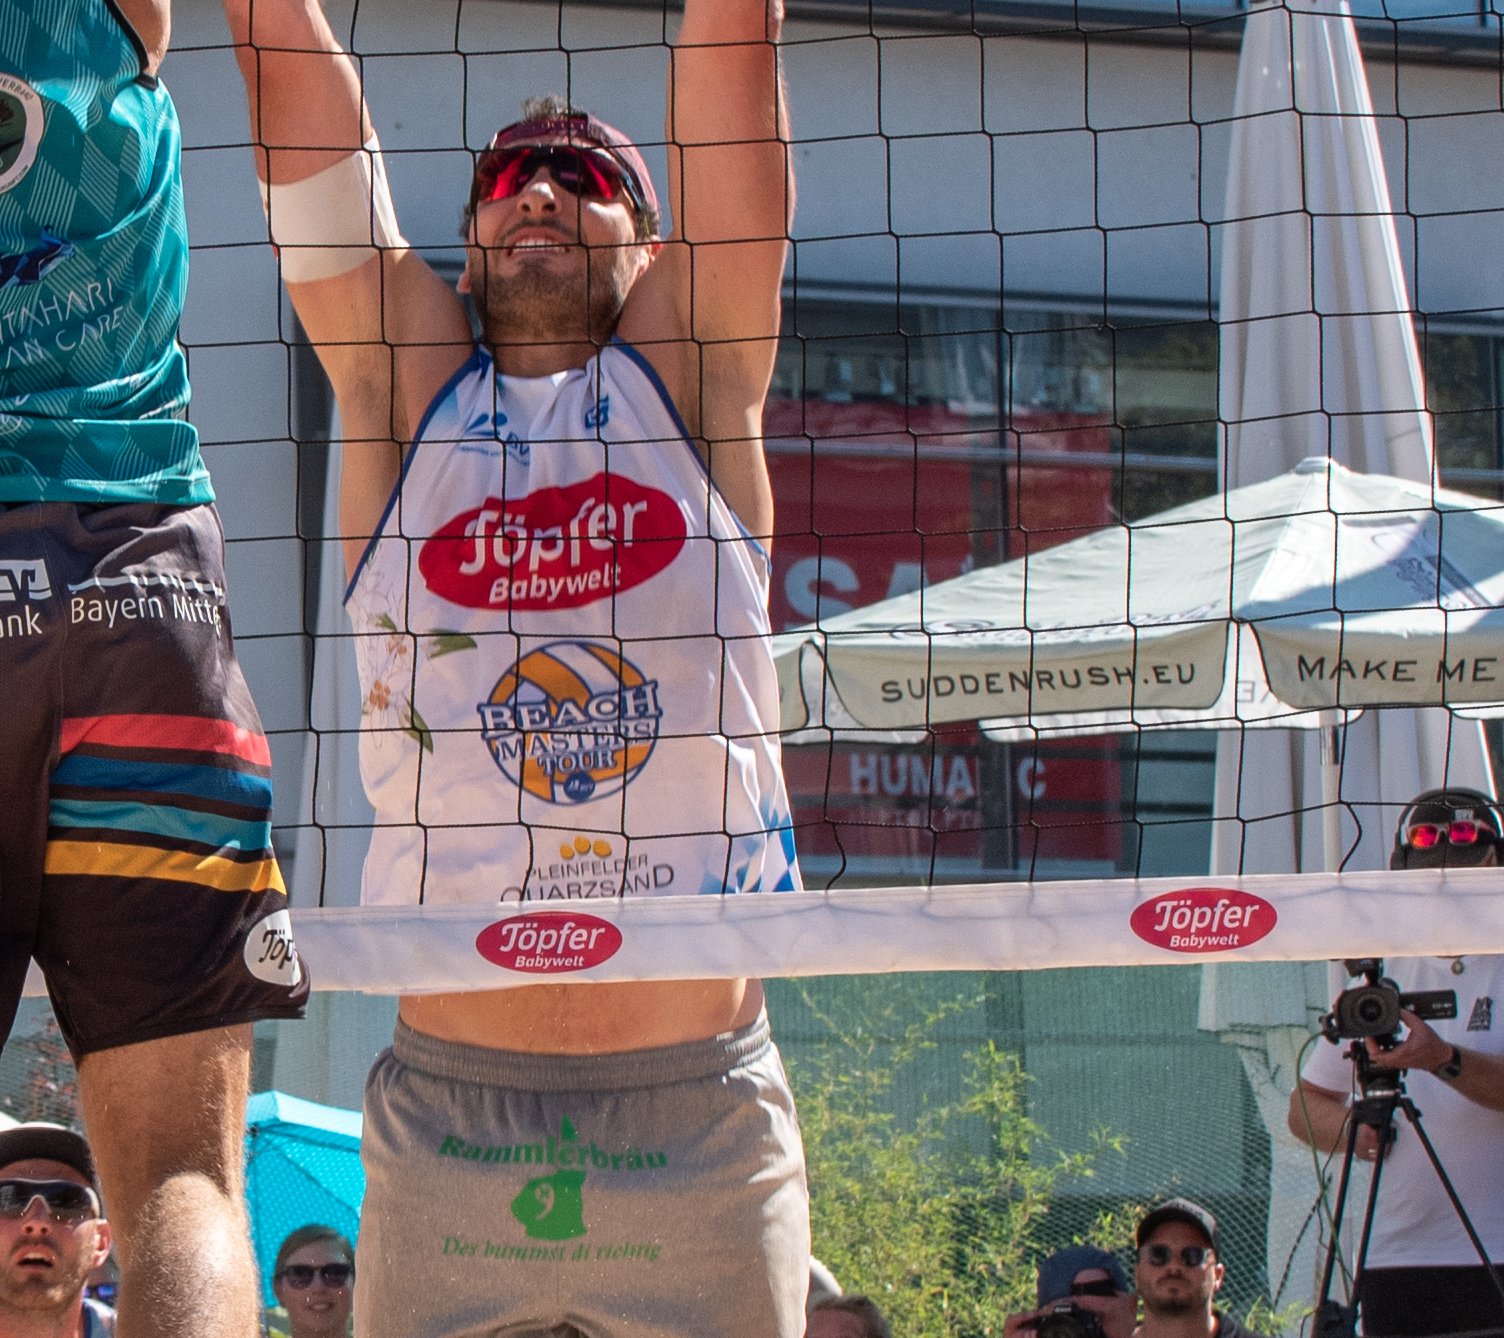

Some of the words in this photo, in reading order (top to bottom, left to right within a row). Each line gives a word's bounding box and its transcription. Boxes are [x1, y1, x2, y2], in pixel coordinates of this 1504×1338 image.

[54, 306, 123, 354] CARE
[458, 497, 648, 575] Töpfer
[488, 560, 622, 605] Babywelt
[69, 593, 165, 632] Bayern
[880, 662, 1196, 704] SUDDENRUSH.EU
[1296, 652, 1417, 683] MAKE
[1437, 655, 1497, 682] ME
[476, 679, 664, 741] BEACH
[498, 719, 654, 763] MASTERS
[536, 748, 617, 777] TOUR
[1154, 898, 1259, 933] Töpfer
[499, 921, 605, 955] Töpfer
[1169, 934, 1238, 947] Babywelt
[515, 956, 584, 968] Babywelt
[438, 1134, 668, 1171] Rammlerbräu
